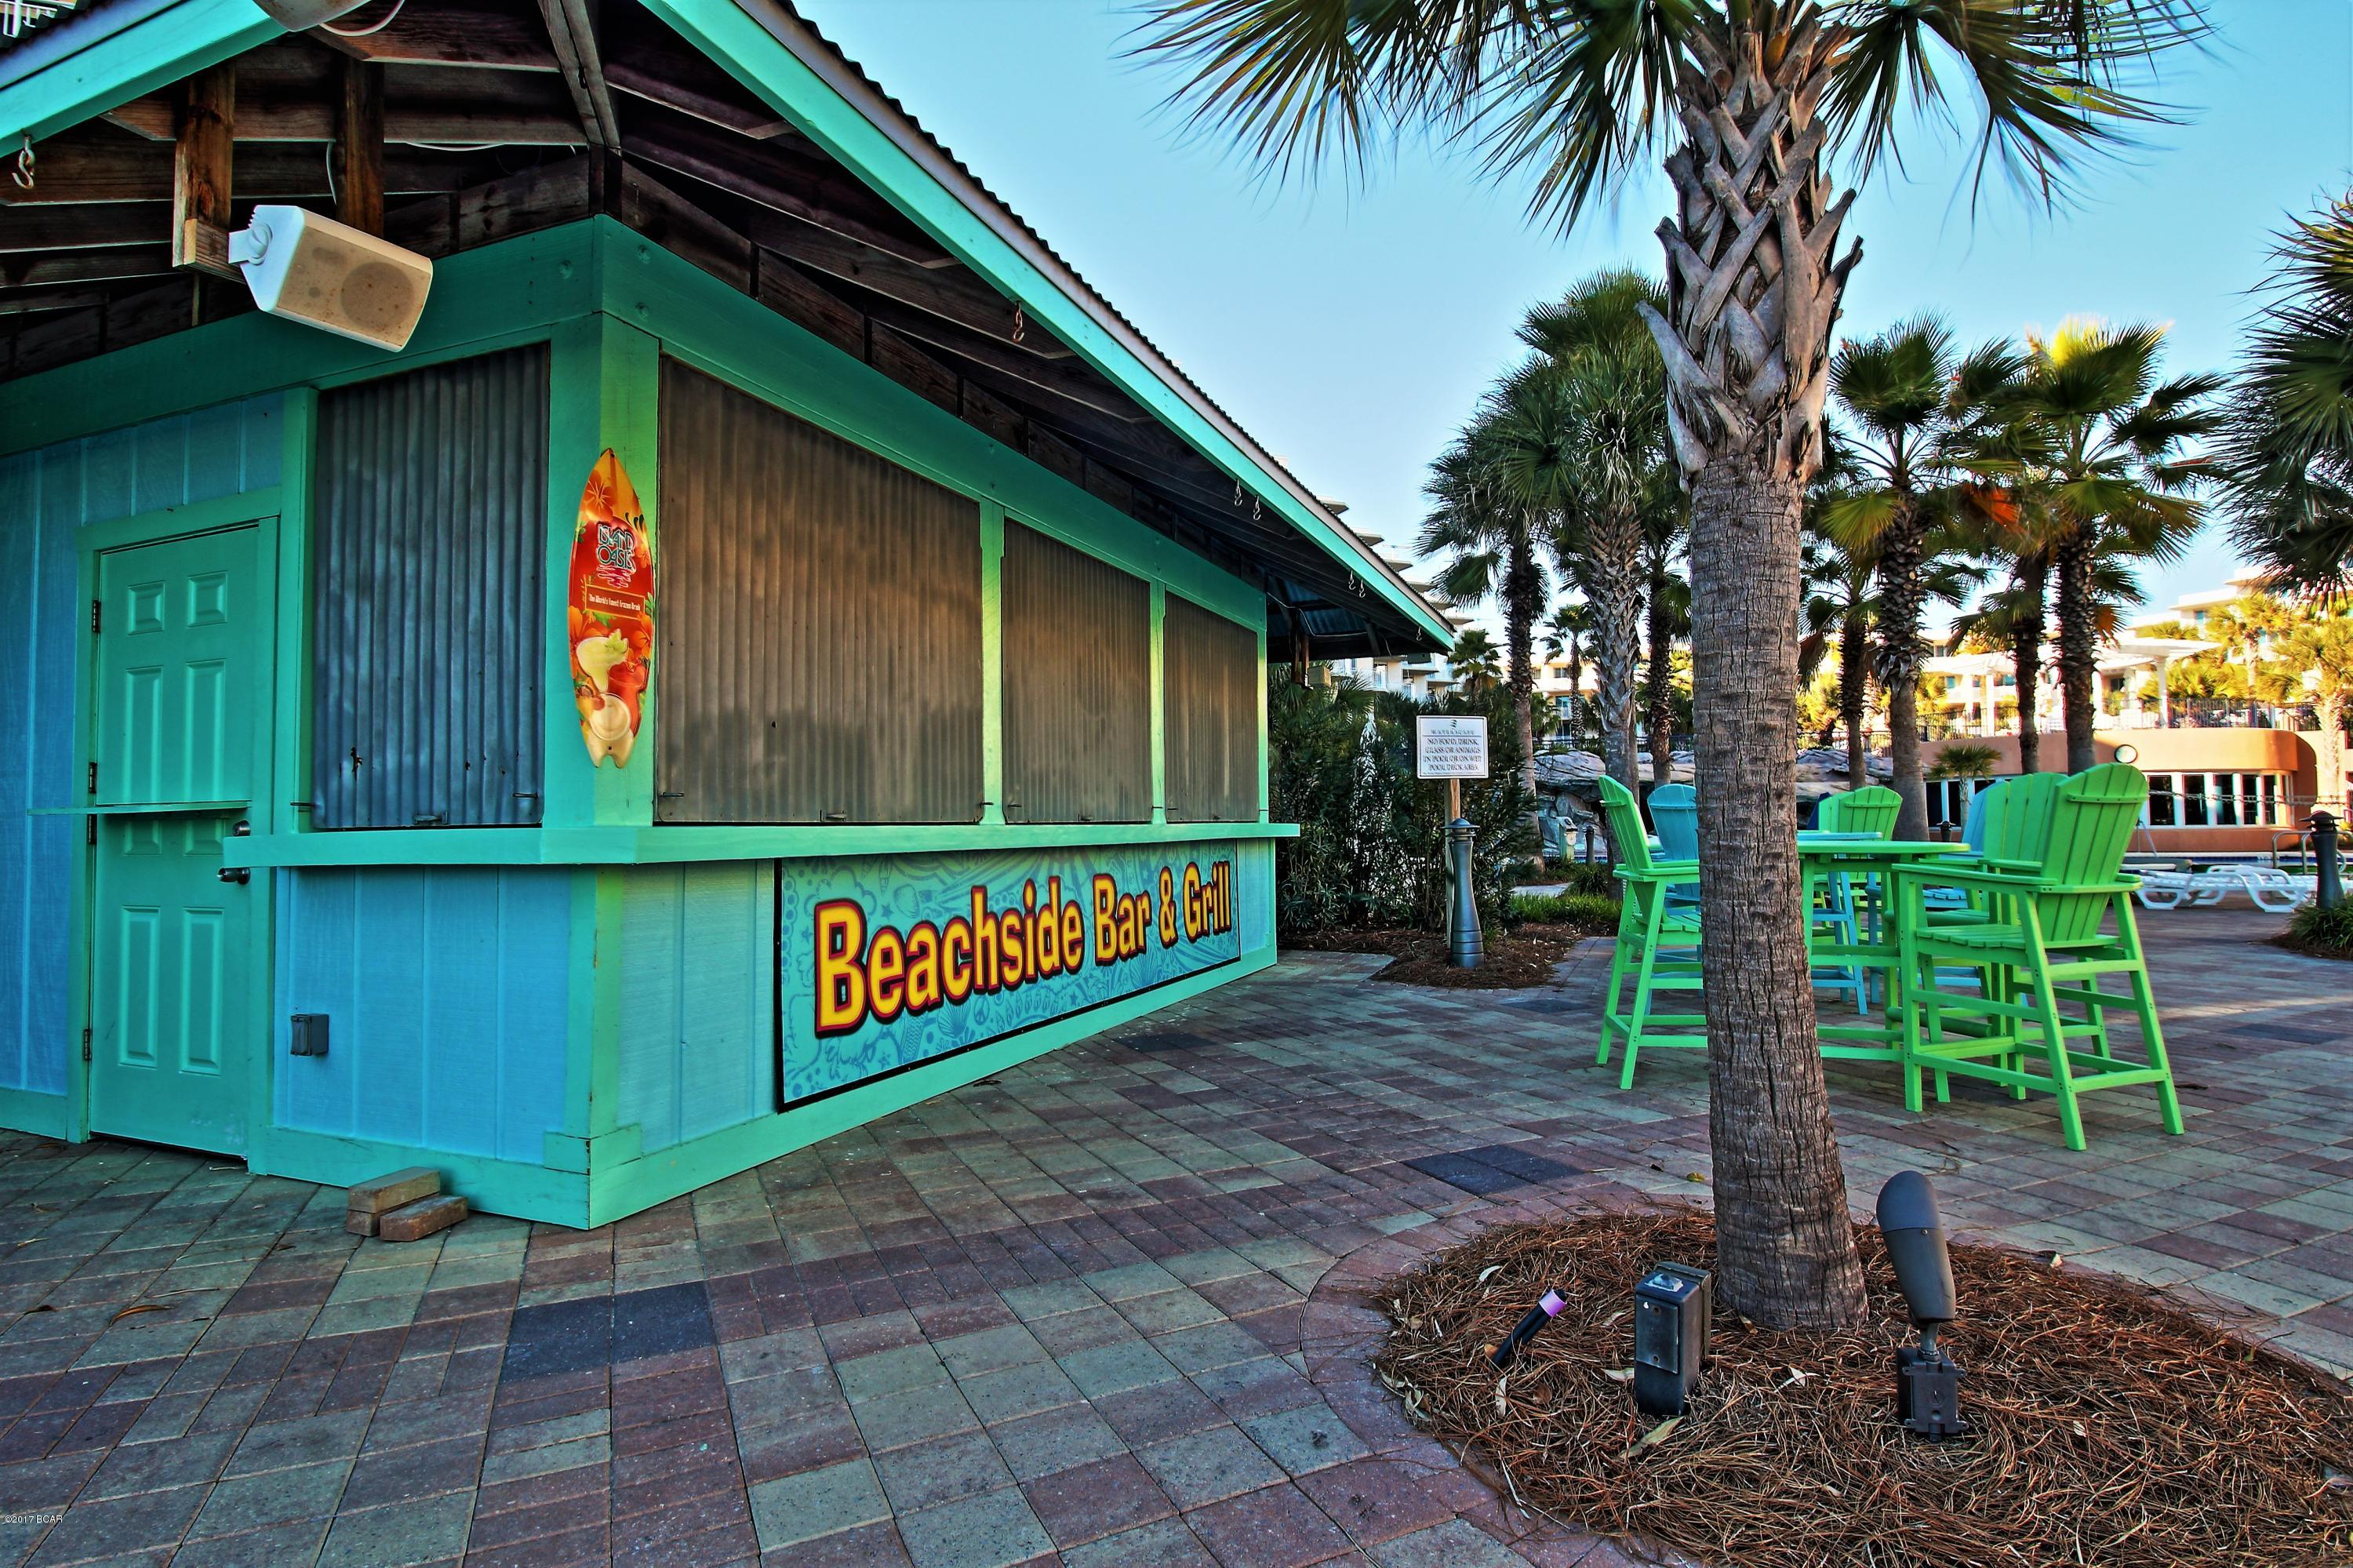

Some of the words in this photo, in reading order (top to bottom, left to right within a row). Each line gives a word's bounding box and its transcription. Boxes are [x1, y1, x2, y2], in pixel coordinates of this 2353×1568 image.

[598, 524, 635, 551] ISLAND
[596, 544, 636, 573] OASIS
[813, 875, 1086, 1039] Beachside
[1093, 872, 1151, 966] Bar
[1158, 865, 1177, 948] &
[1182, 860, 1232, 944] Grill
